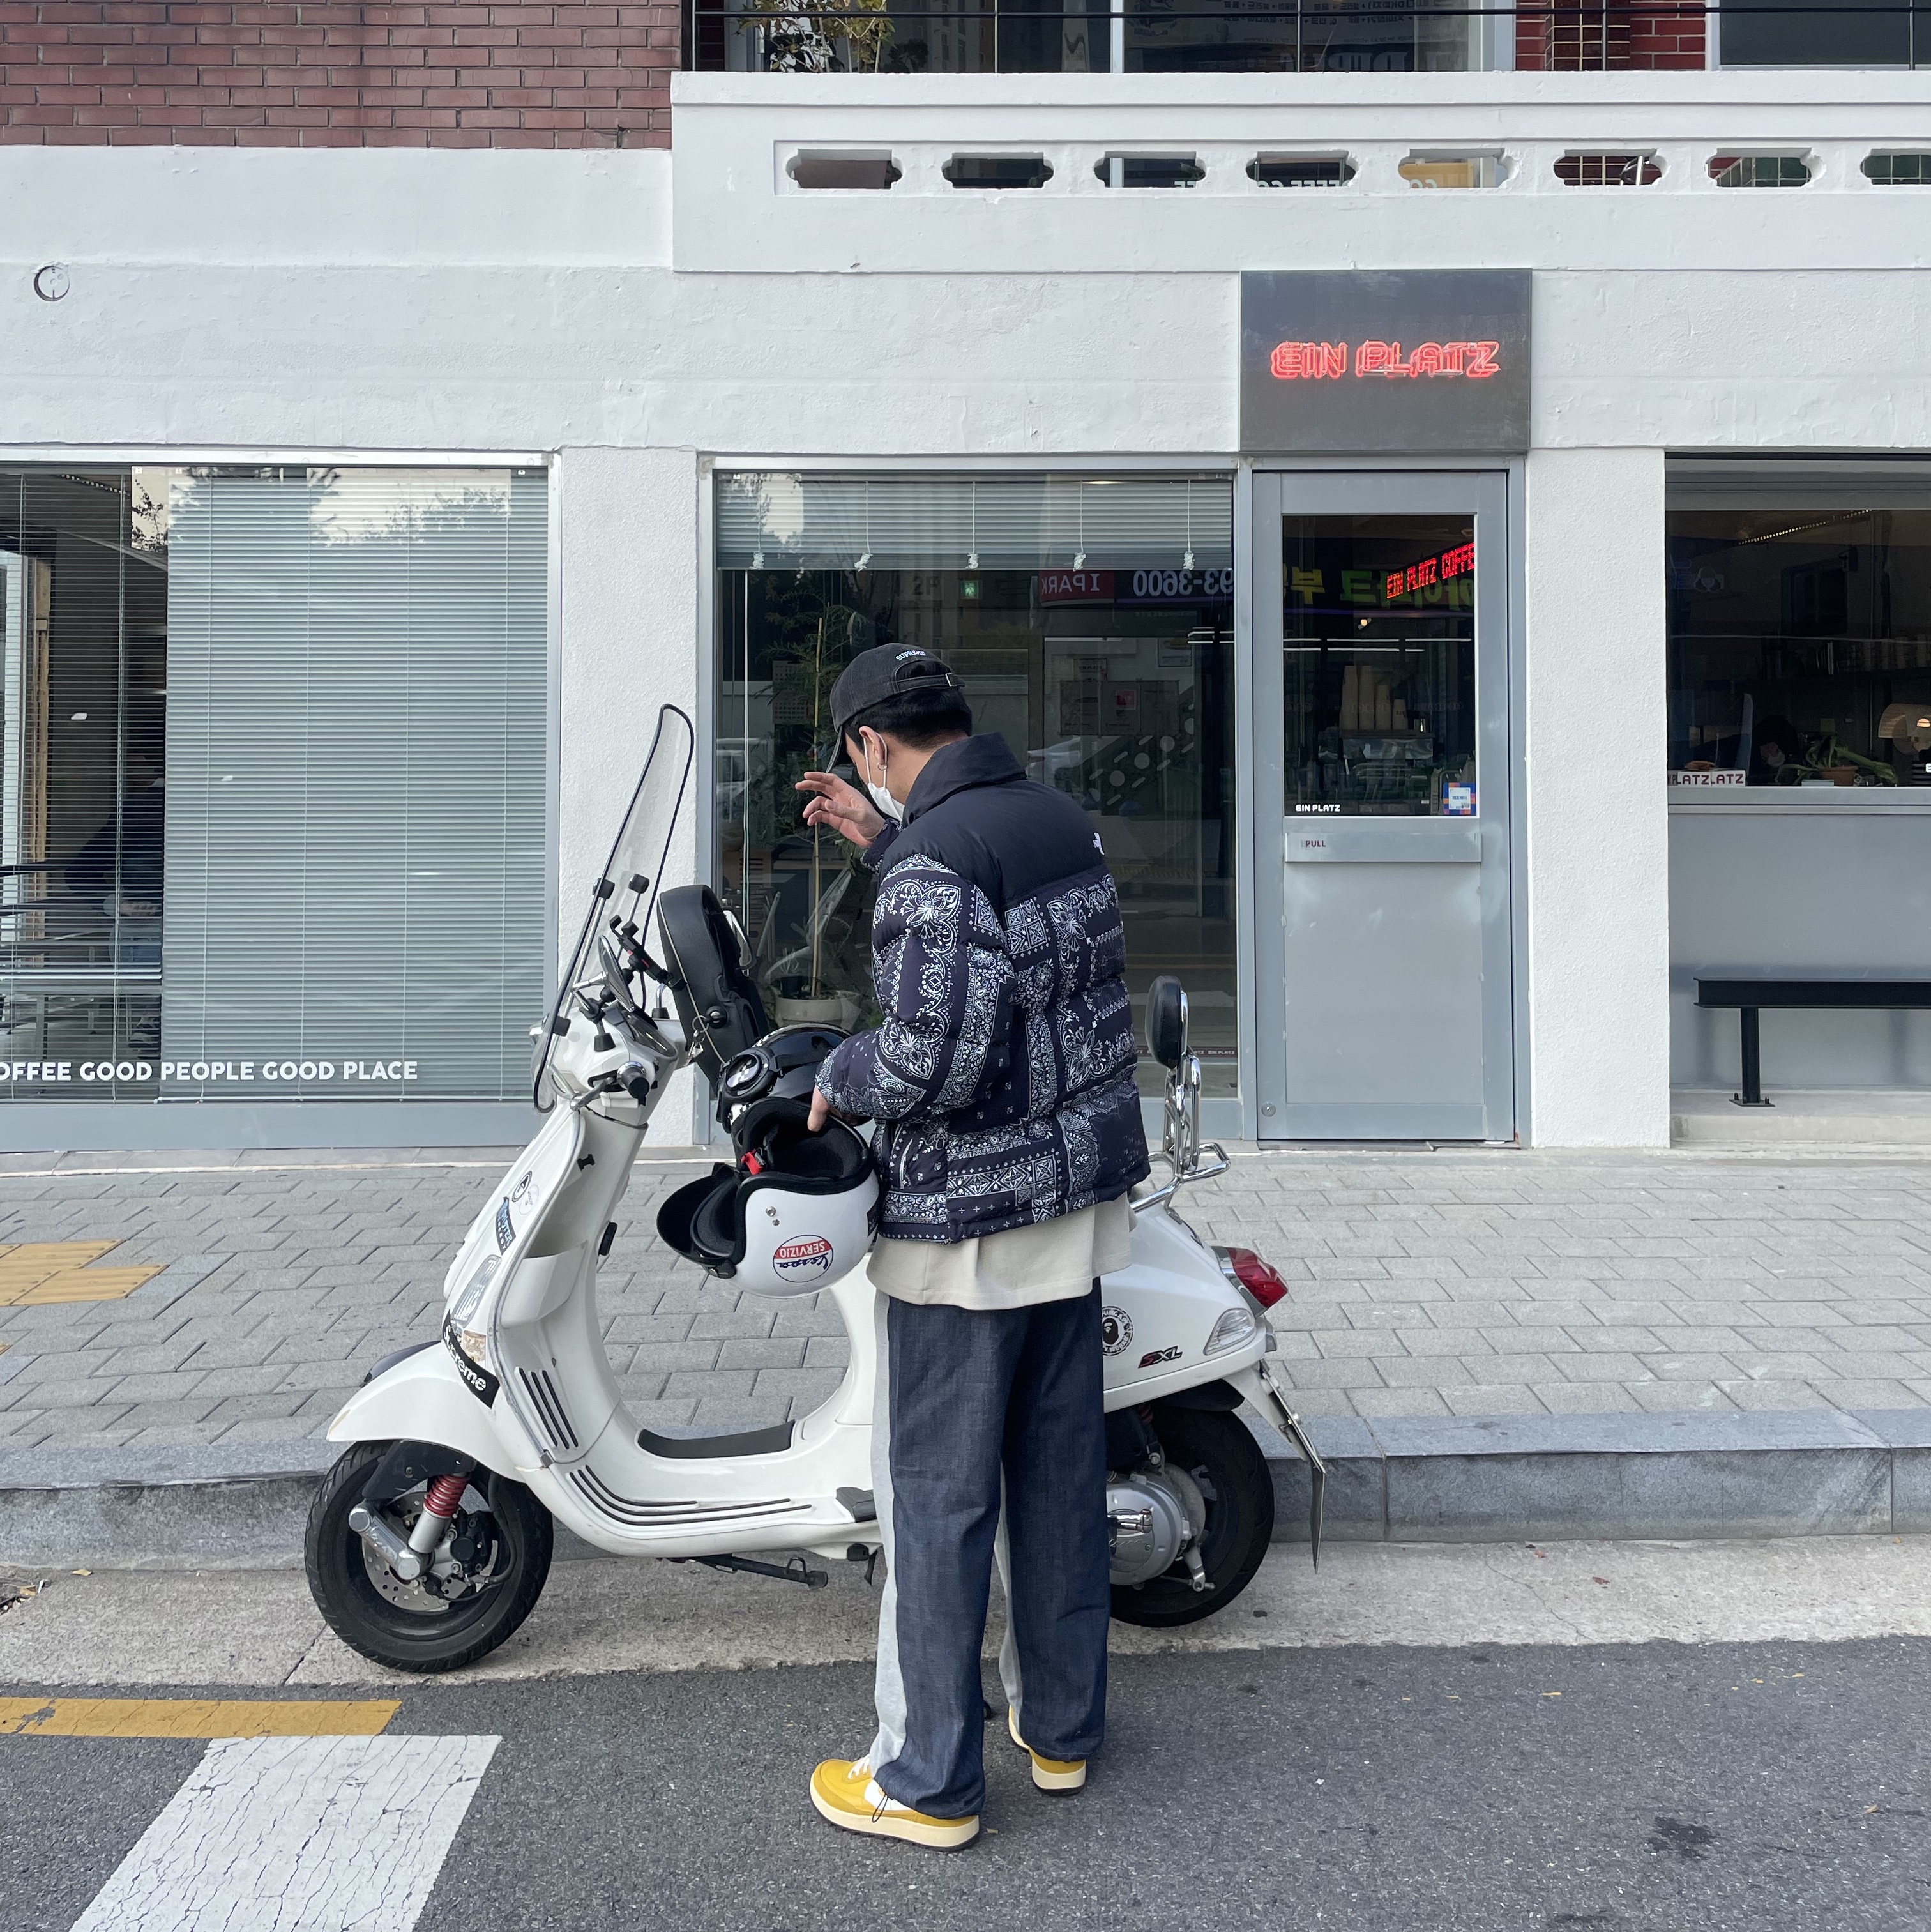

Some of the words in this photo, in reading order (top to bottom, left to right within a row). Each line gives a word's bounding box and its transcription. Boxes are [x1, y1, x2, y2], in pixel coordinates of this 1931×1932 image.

[1271, 340, 1347, 379] EIN
[1355, 340, 1501, 379] PLATZ
[1386, 570, 1404, 599] EIN
[1407, 557, 1437, 592] PLATZ
[80, 1061, 153, 1081] GOOD
[161, 1061, 254, 1081] PEOPLE
[262, 1061, 335, 1081] GOOD
[344, 1061, 418, 1080] PLACE
[779, 1241, 825, 1258] SERVIZIO
[776, 1252, 828, 1270] Vespa
